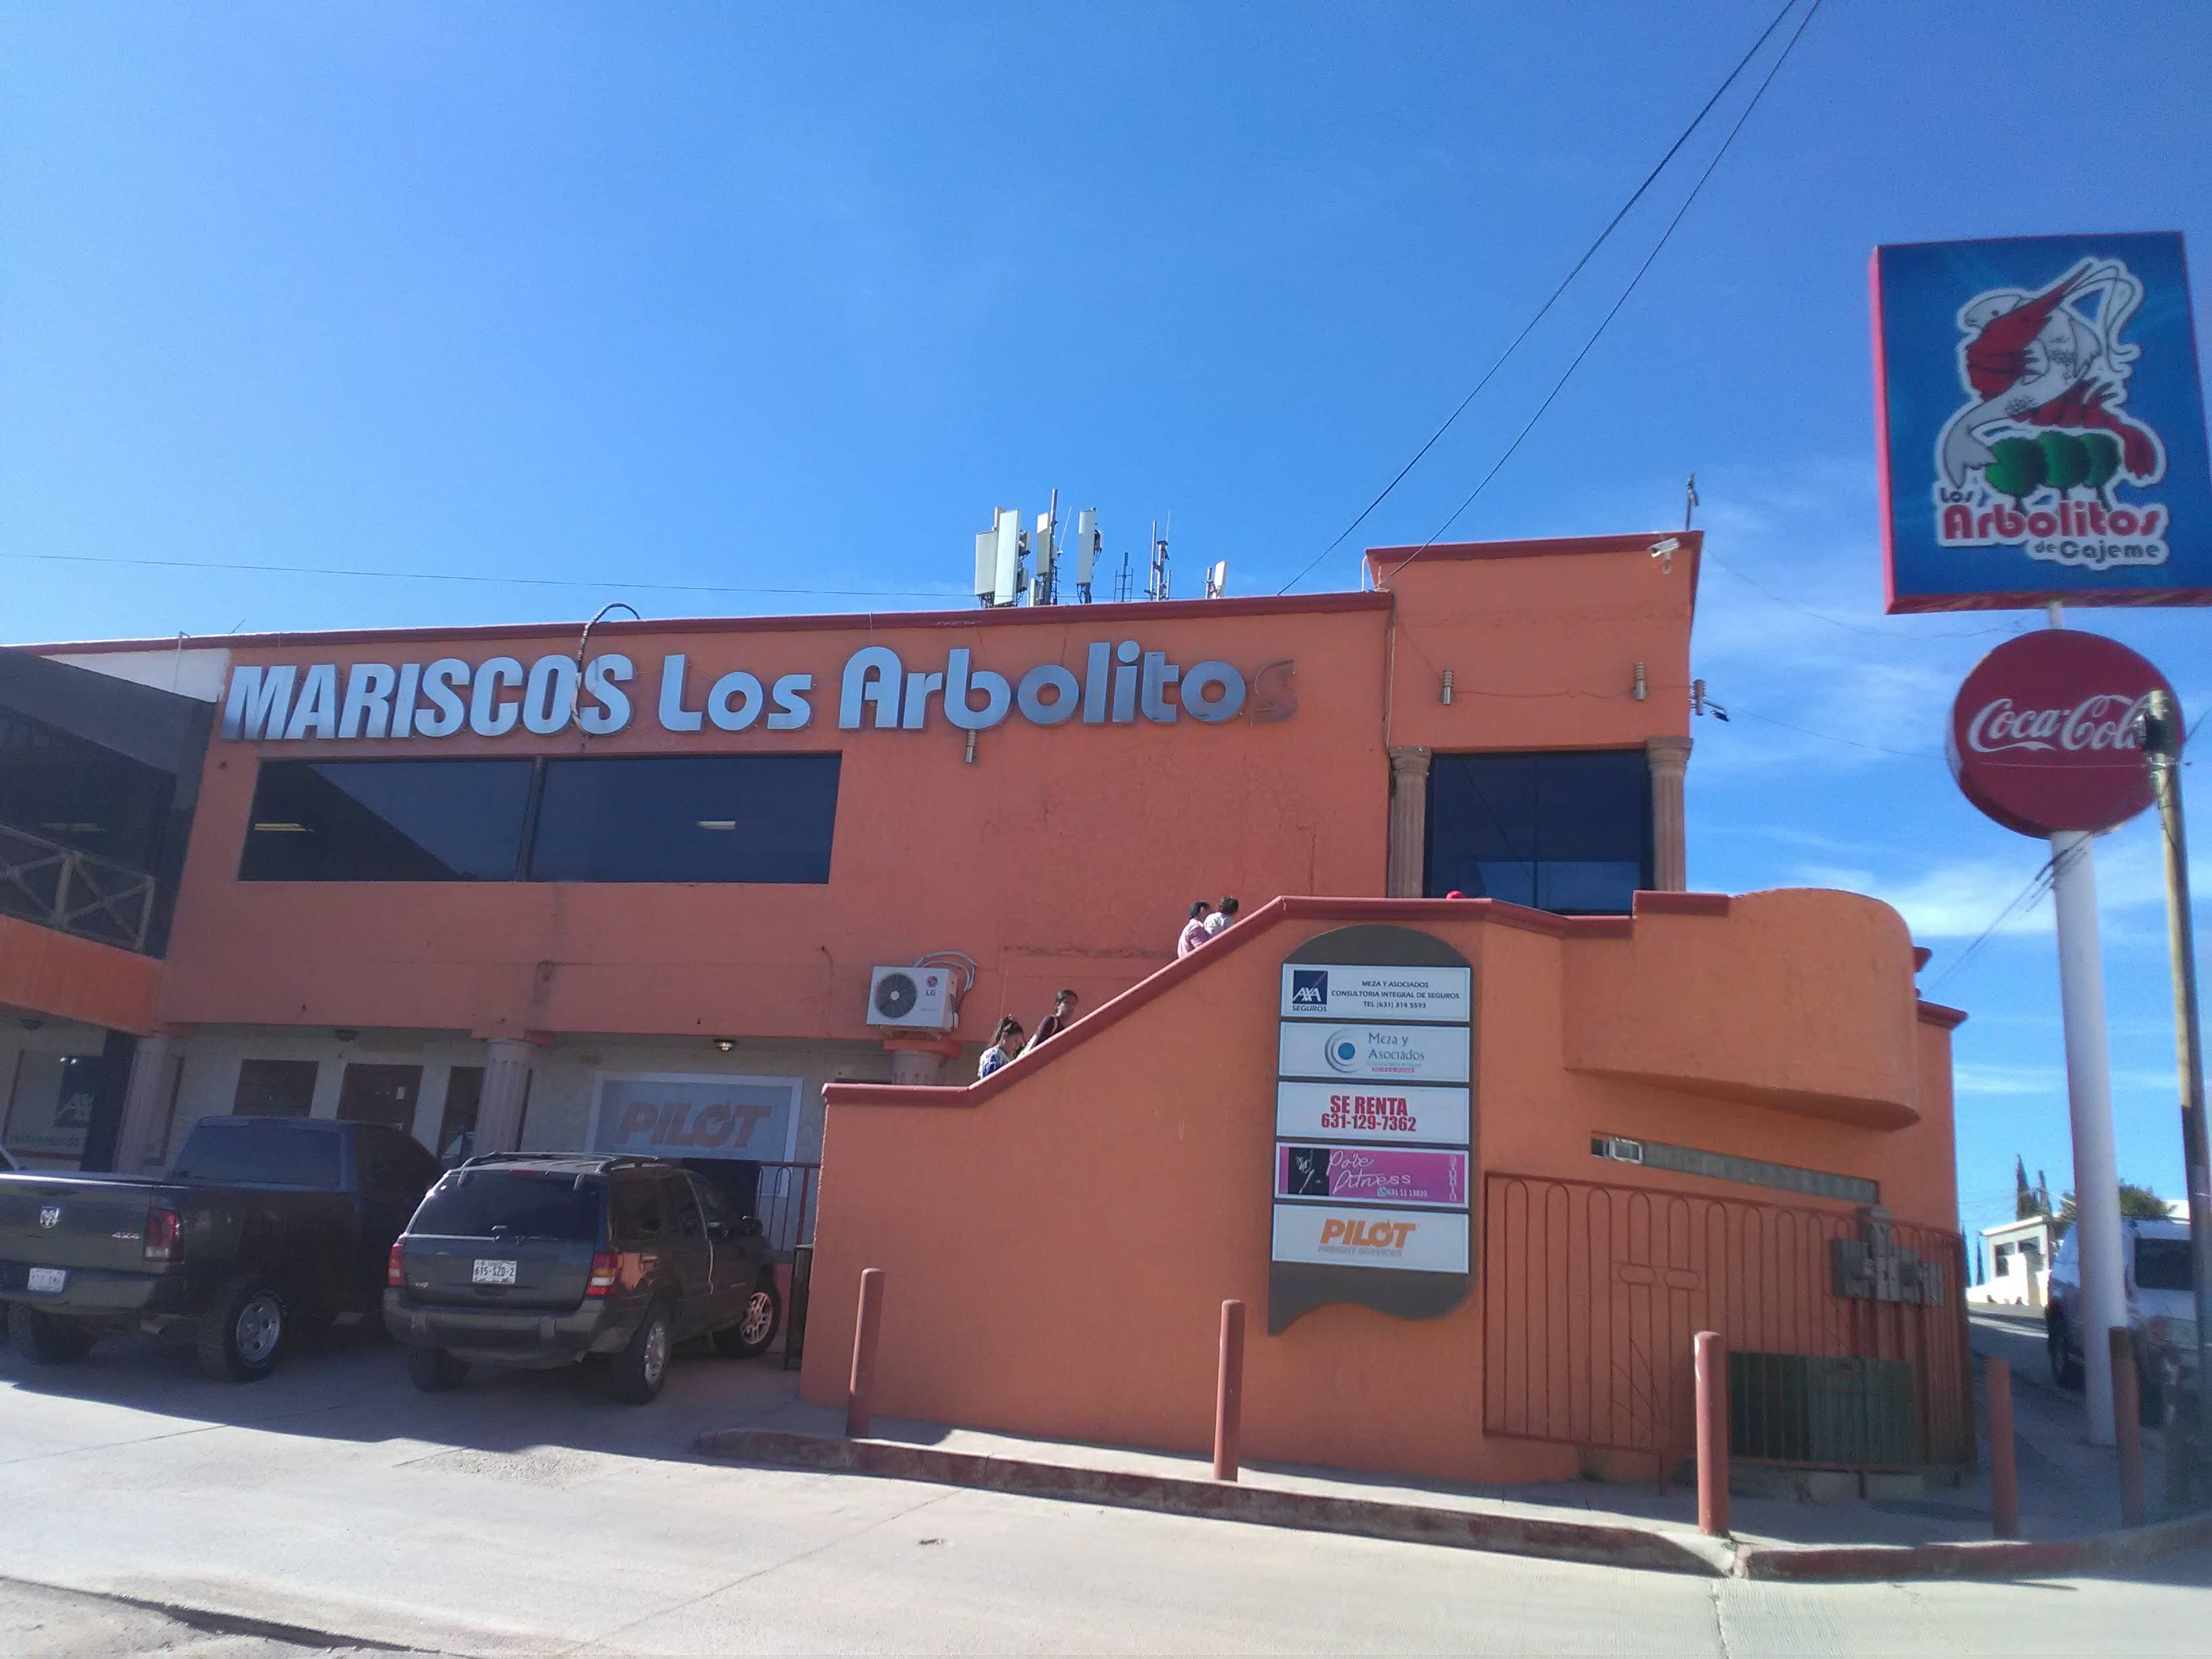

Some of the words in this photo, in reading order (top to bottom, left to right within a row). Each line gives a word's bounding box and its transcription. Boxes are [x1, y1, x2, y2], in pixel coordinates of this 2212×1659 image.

[1939, 487, 1974, 504] Los
[1943, 501, 2161, 540] Arbolitos
[2034, 541, 2056, 554] de
[2060, 540, 2161, 564] Cajeme
[220, 653, 635, 740] MARISCOS
[659, 654, 813, 732] Los
[1967, 693, 2152, 753] Coca-Col
[1292, 987, 1322, 1002] AXA
[1376, 1001, 1393, 1009] (631)
[1368, 1032, 1398, 1044] Meza
[1401, 1036, 1409, 1047] y
[1368, 1048, 1425, 1061] Asociados
[1330, 1095, 1350, 1113] SE
[1354, 1096, 1408, 1116] RENTA
[617, 1101, 773, 1148] PILOT
[1321, 1113, 1417, 1132] 631-129-7362
[1319, 1218, 1417, 1248] PILOT
